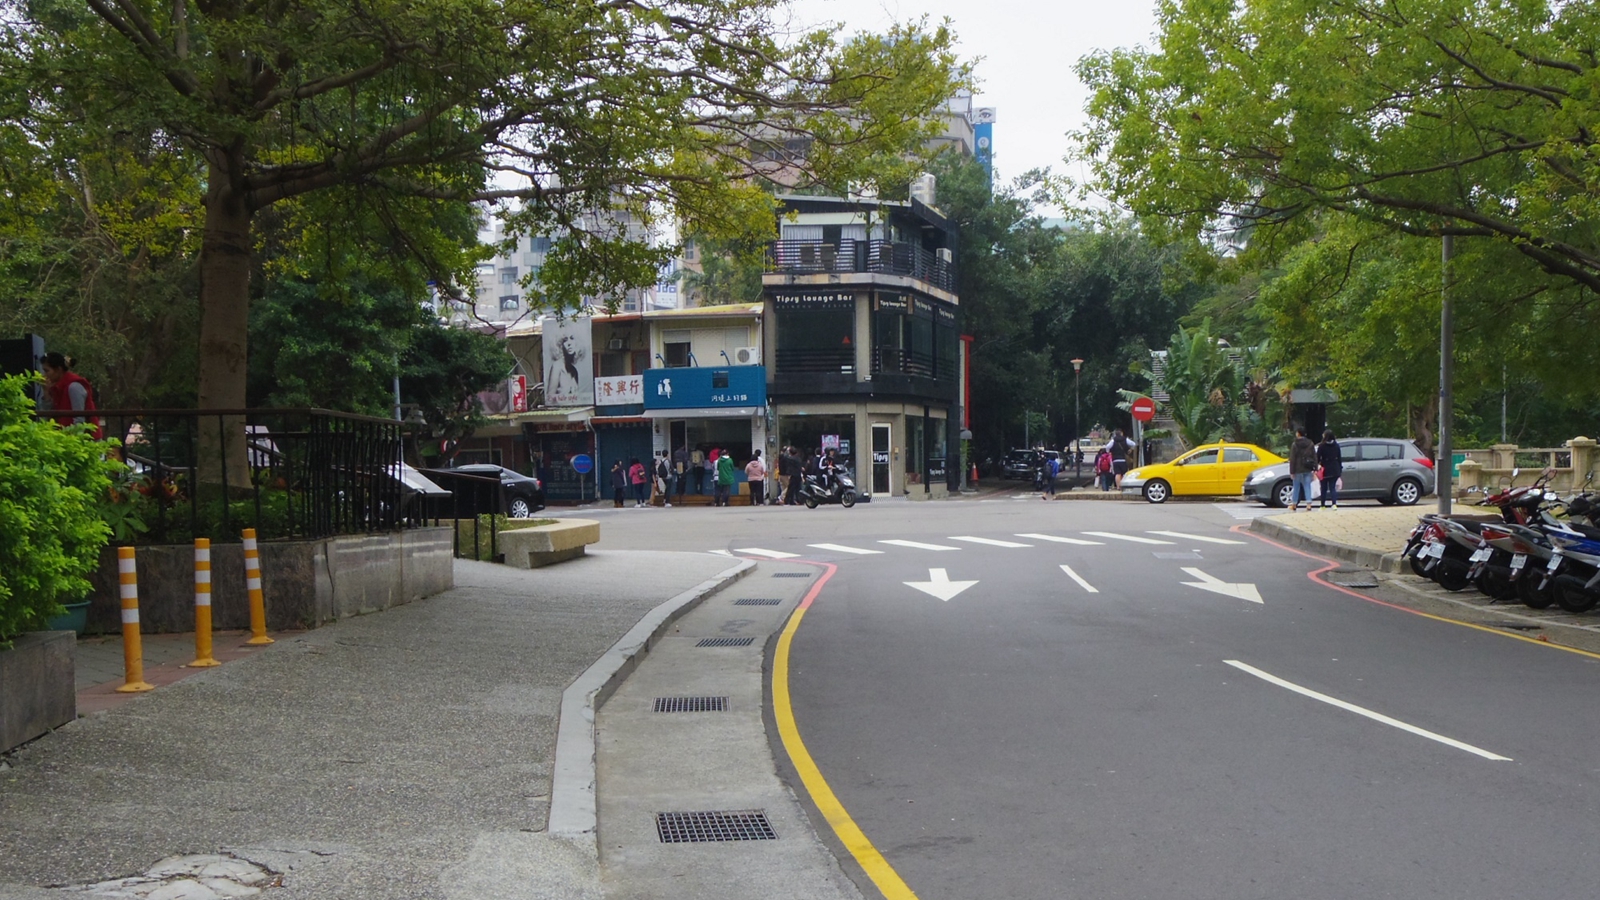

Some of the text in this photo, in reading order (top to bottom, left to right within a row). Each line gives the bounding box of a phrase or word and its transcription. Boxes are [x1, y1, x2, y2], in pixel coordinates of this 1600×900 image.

[776, 295, 800, 304] Tipsy
[802, 294, 834, 303] Lounge
[873, 452, 889, 462] Tipsy
